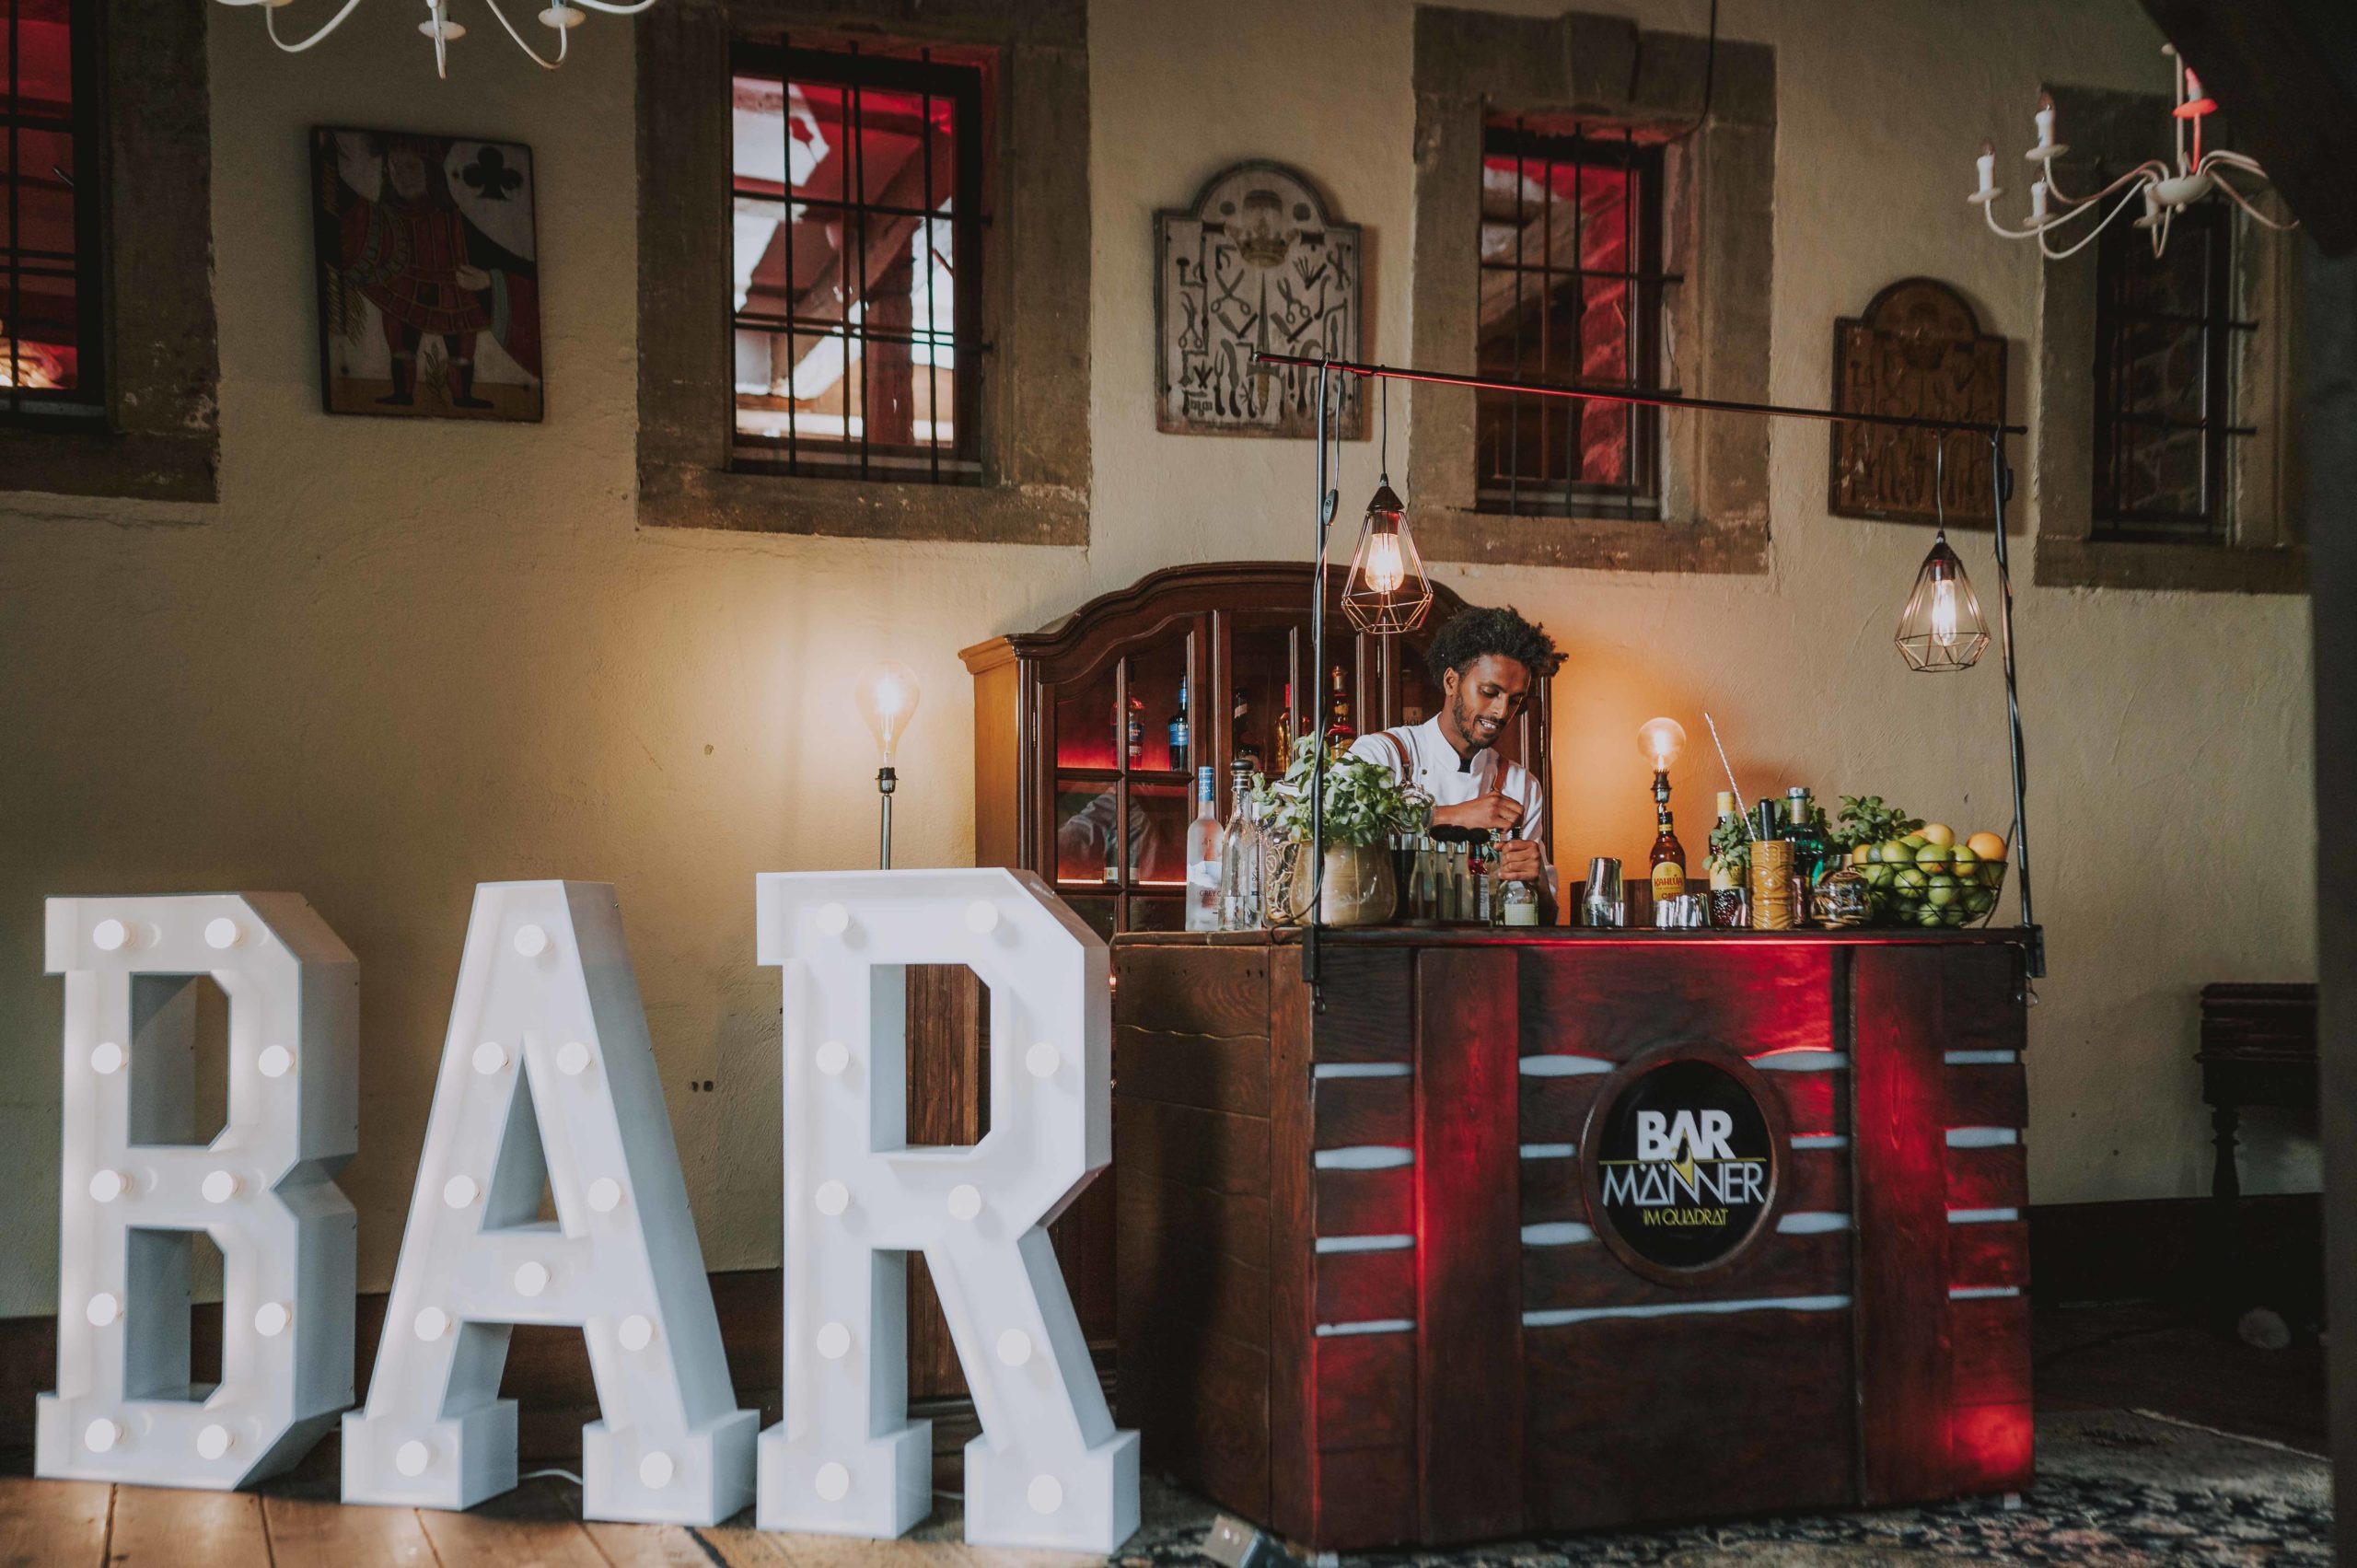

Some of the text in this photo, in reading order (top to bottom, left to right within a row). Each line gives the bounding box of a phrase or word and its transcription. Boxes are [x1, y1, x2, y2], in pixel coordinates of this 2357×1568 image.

[1637, 1109, 1736, 1161] BAR
[1602, 1162, 1765, 1206] MÄNNER
[35, 867, 1141, 1554] BAR
[1643, 1208, 1729, 1225] IM QUADRAT
